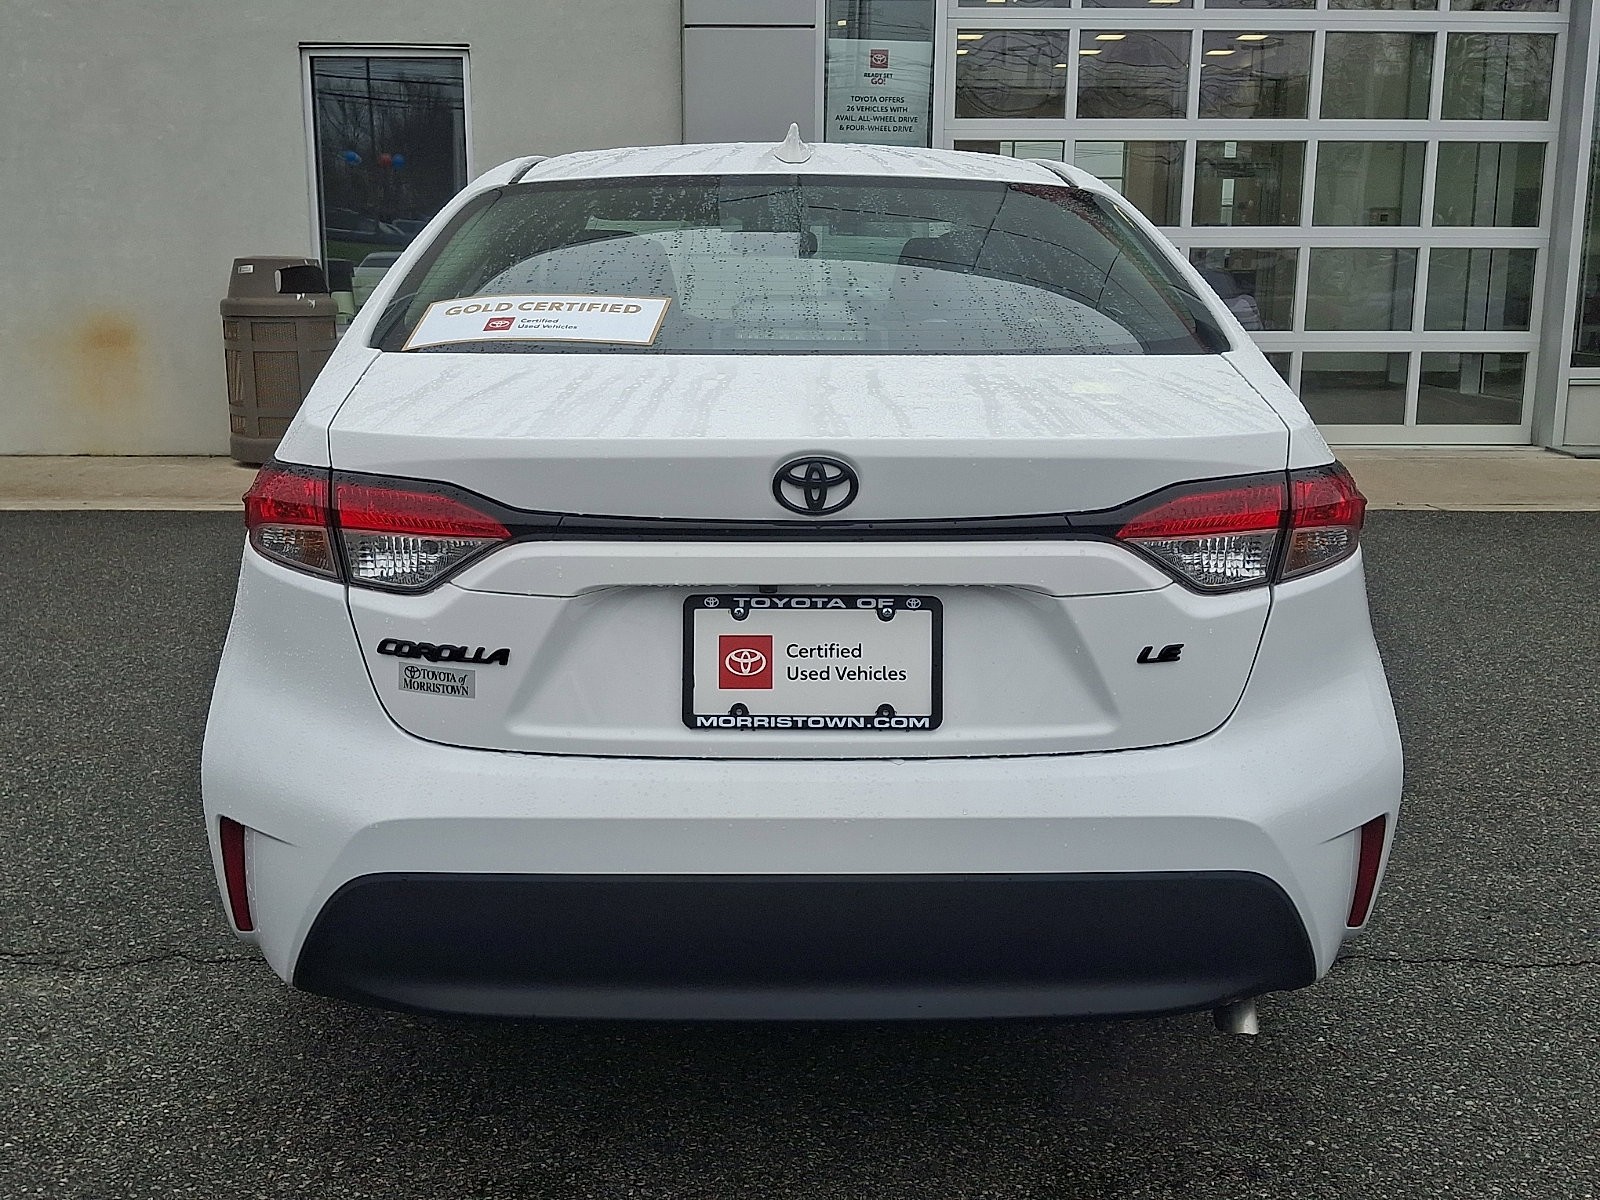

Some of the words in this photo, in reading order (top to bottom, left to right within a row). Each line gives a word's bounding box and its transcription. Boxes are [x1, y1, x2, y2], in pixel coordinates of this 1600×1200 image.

[445, 302, 514, 316] GOLD
[517, 301, 643, 314] CERTIFIED
[734, 598, 846, 608] TOYOTA
[856, 598, 894, 608] OF
[377, 638, 510, 666] COROLLA
[786, 642, 862, 659] Certified
[1136, 644, 1184, 664] LE
[420, 668, 457, 683] TOYOTA
[458, 674, 468, 686] of
[786, 666, 830, 681] Used
[834, 666, 907, 682] Vehicles
[403, 678, 469, 696] MORRISTOWN
[696, 716, 930, 728] MORRISTOWN.COM
